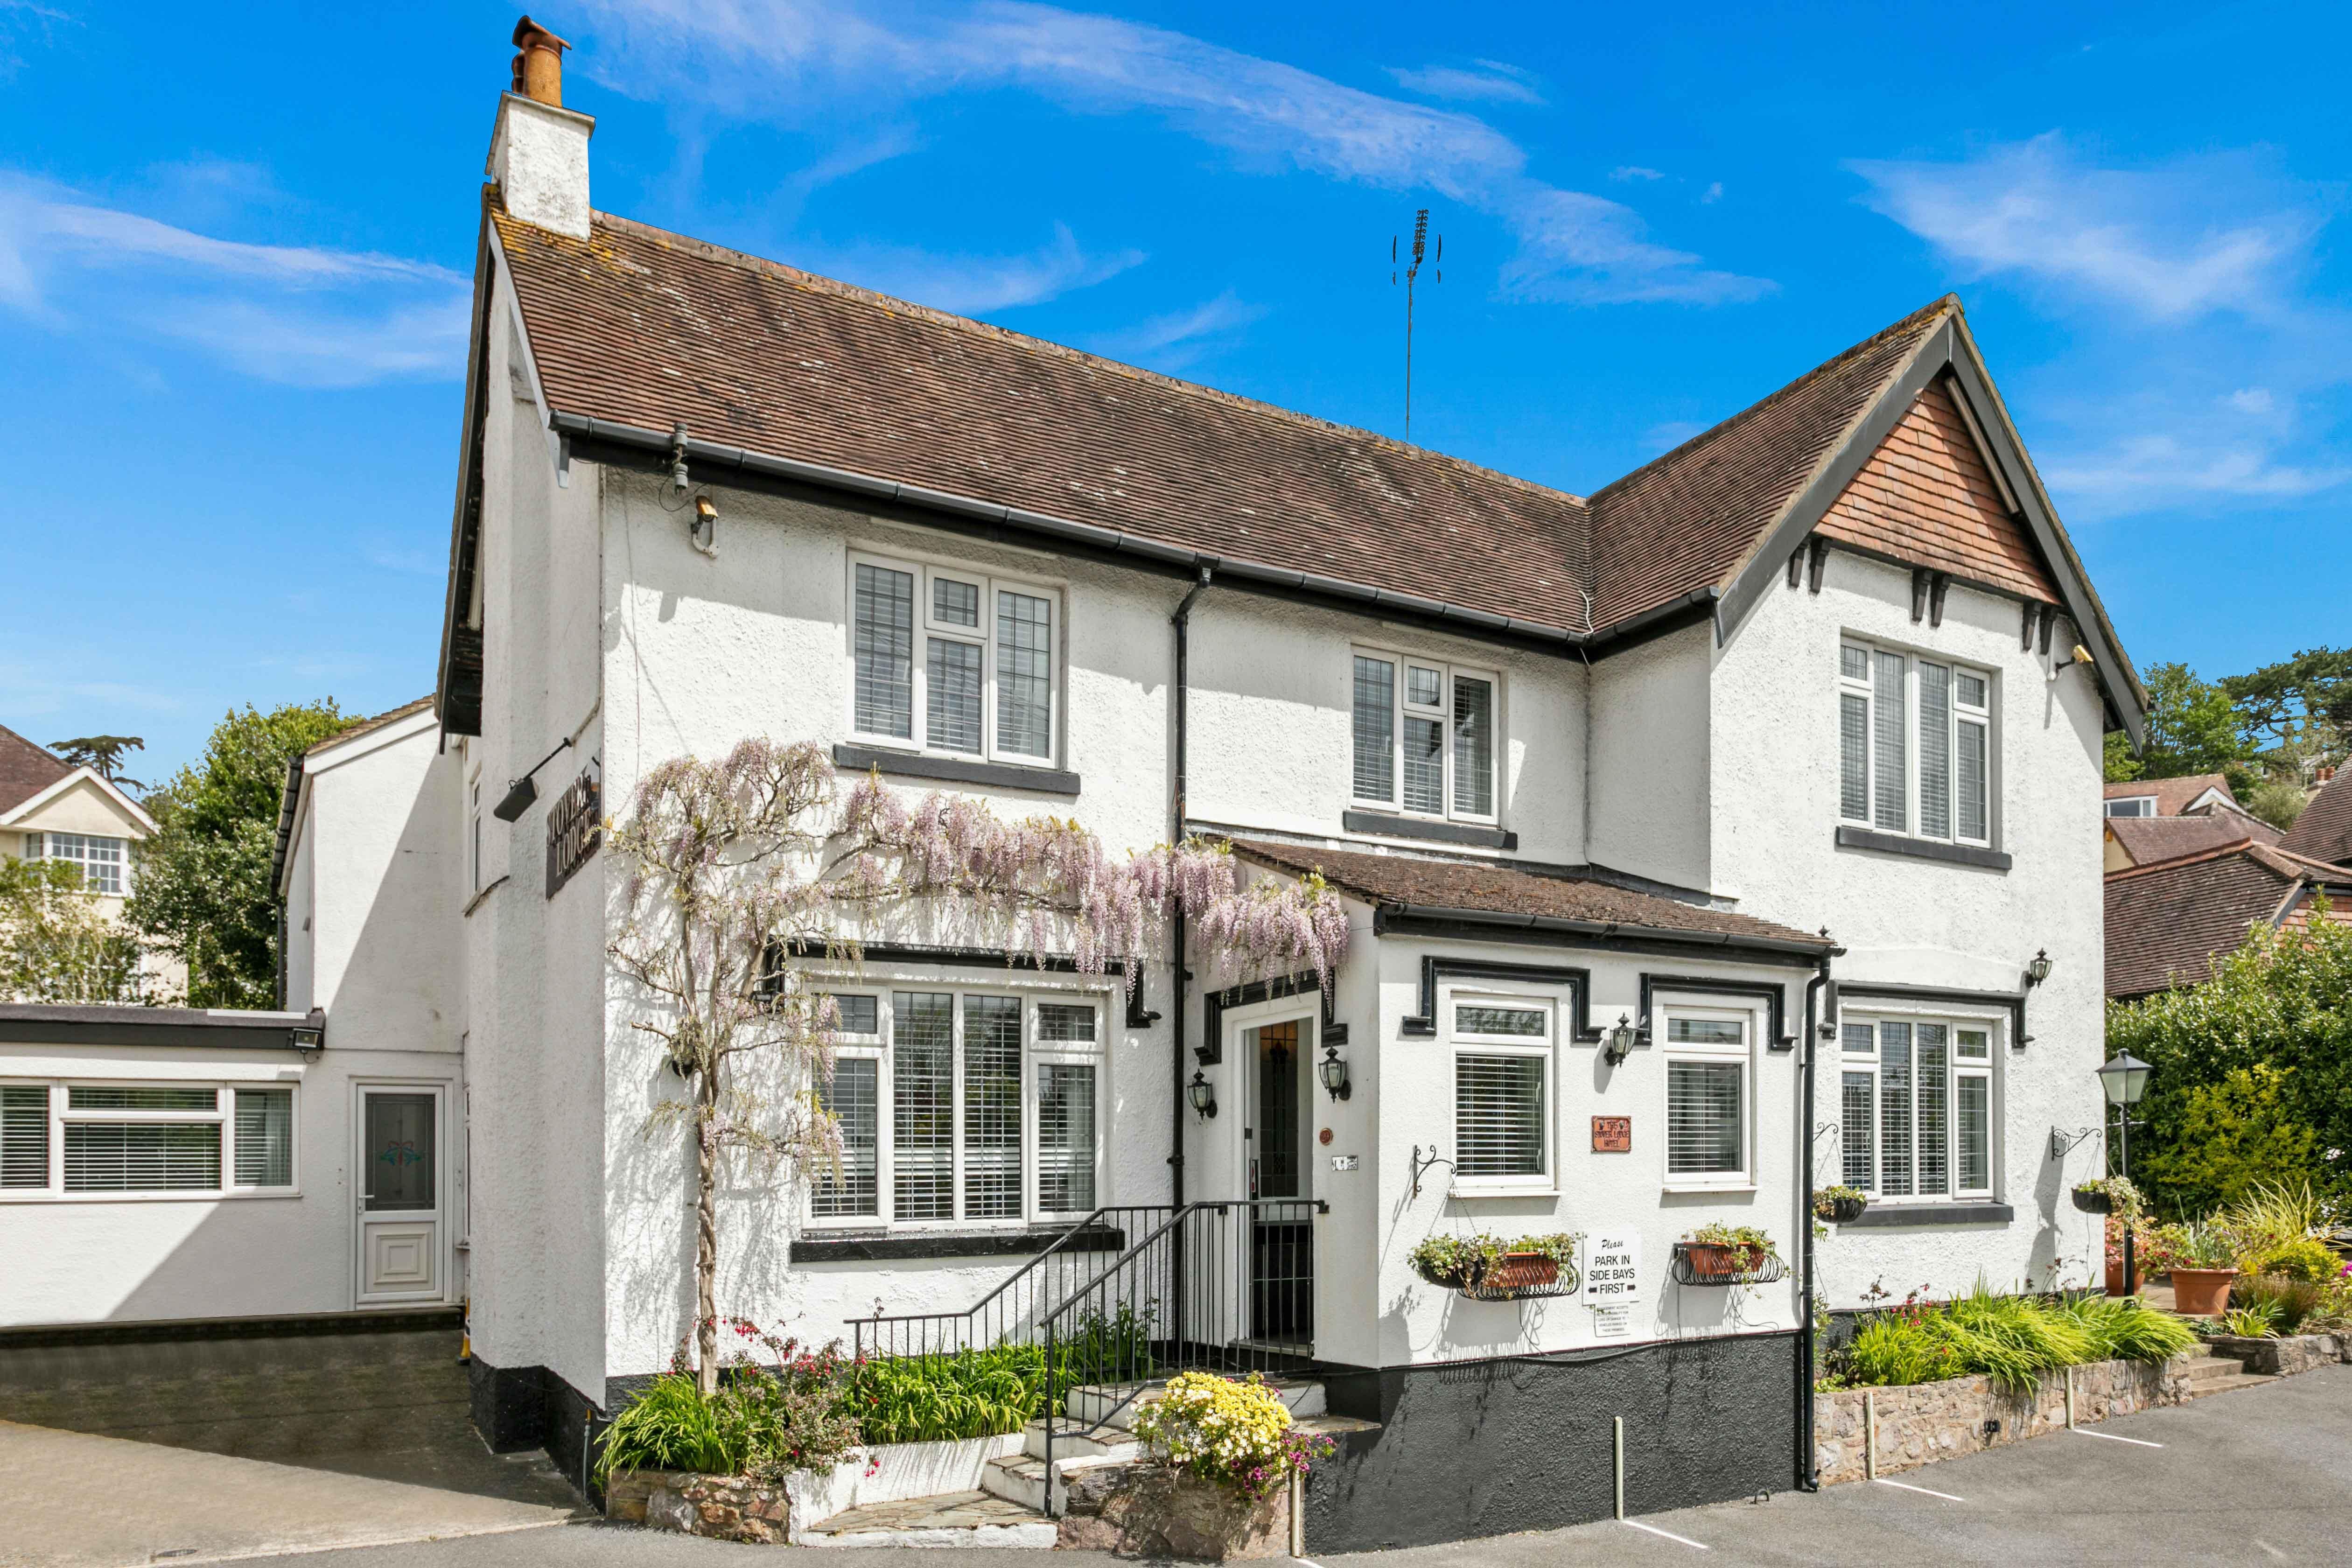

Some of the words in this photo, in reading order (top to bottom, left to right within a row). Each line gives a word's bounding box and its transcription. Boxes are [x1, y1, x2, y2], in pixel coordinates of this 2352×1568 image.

[1601, 1239, 1624, 1250] Please
[1595, 1255, 1618, 1266] PARK
[1621, 1255, 1630, 1265] IN
[1589, 1270, 1610, 1281] SIDE
[1613, 1268, 1635, 1279] BAYS
[1600, 1283, 1625, 1294] FIRST
